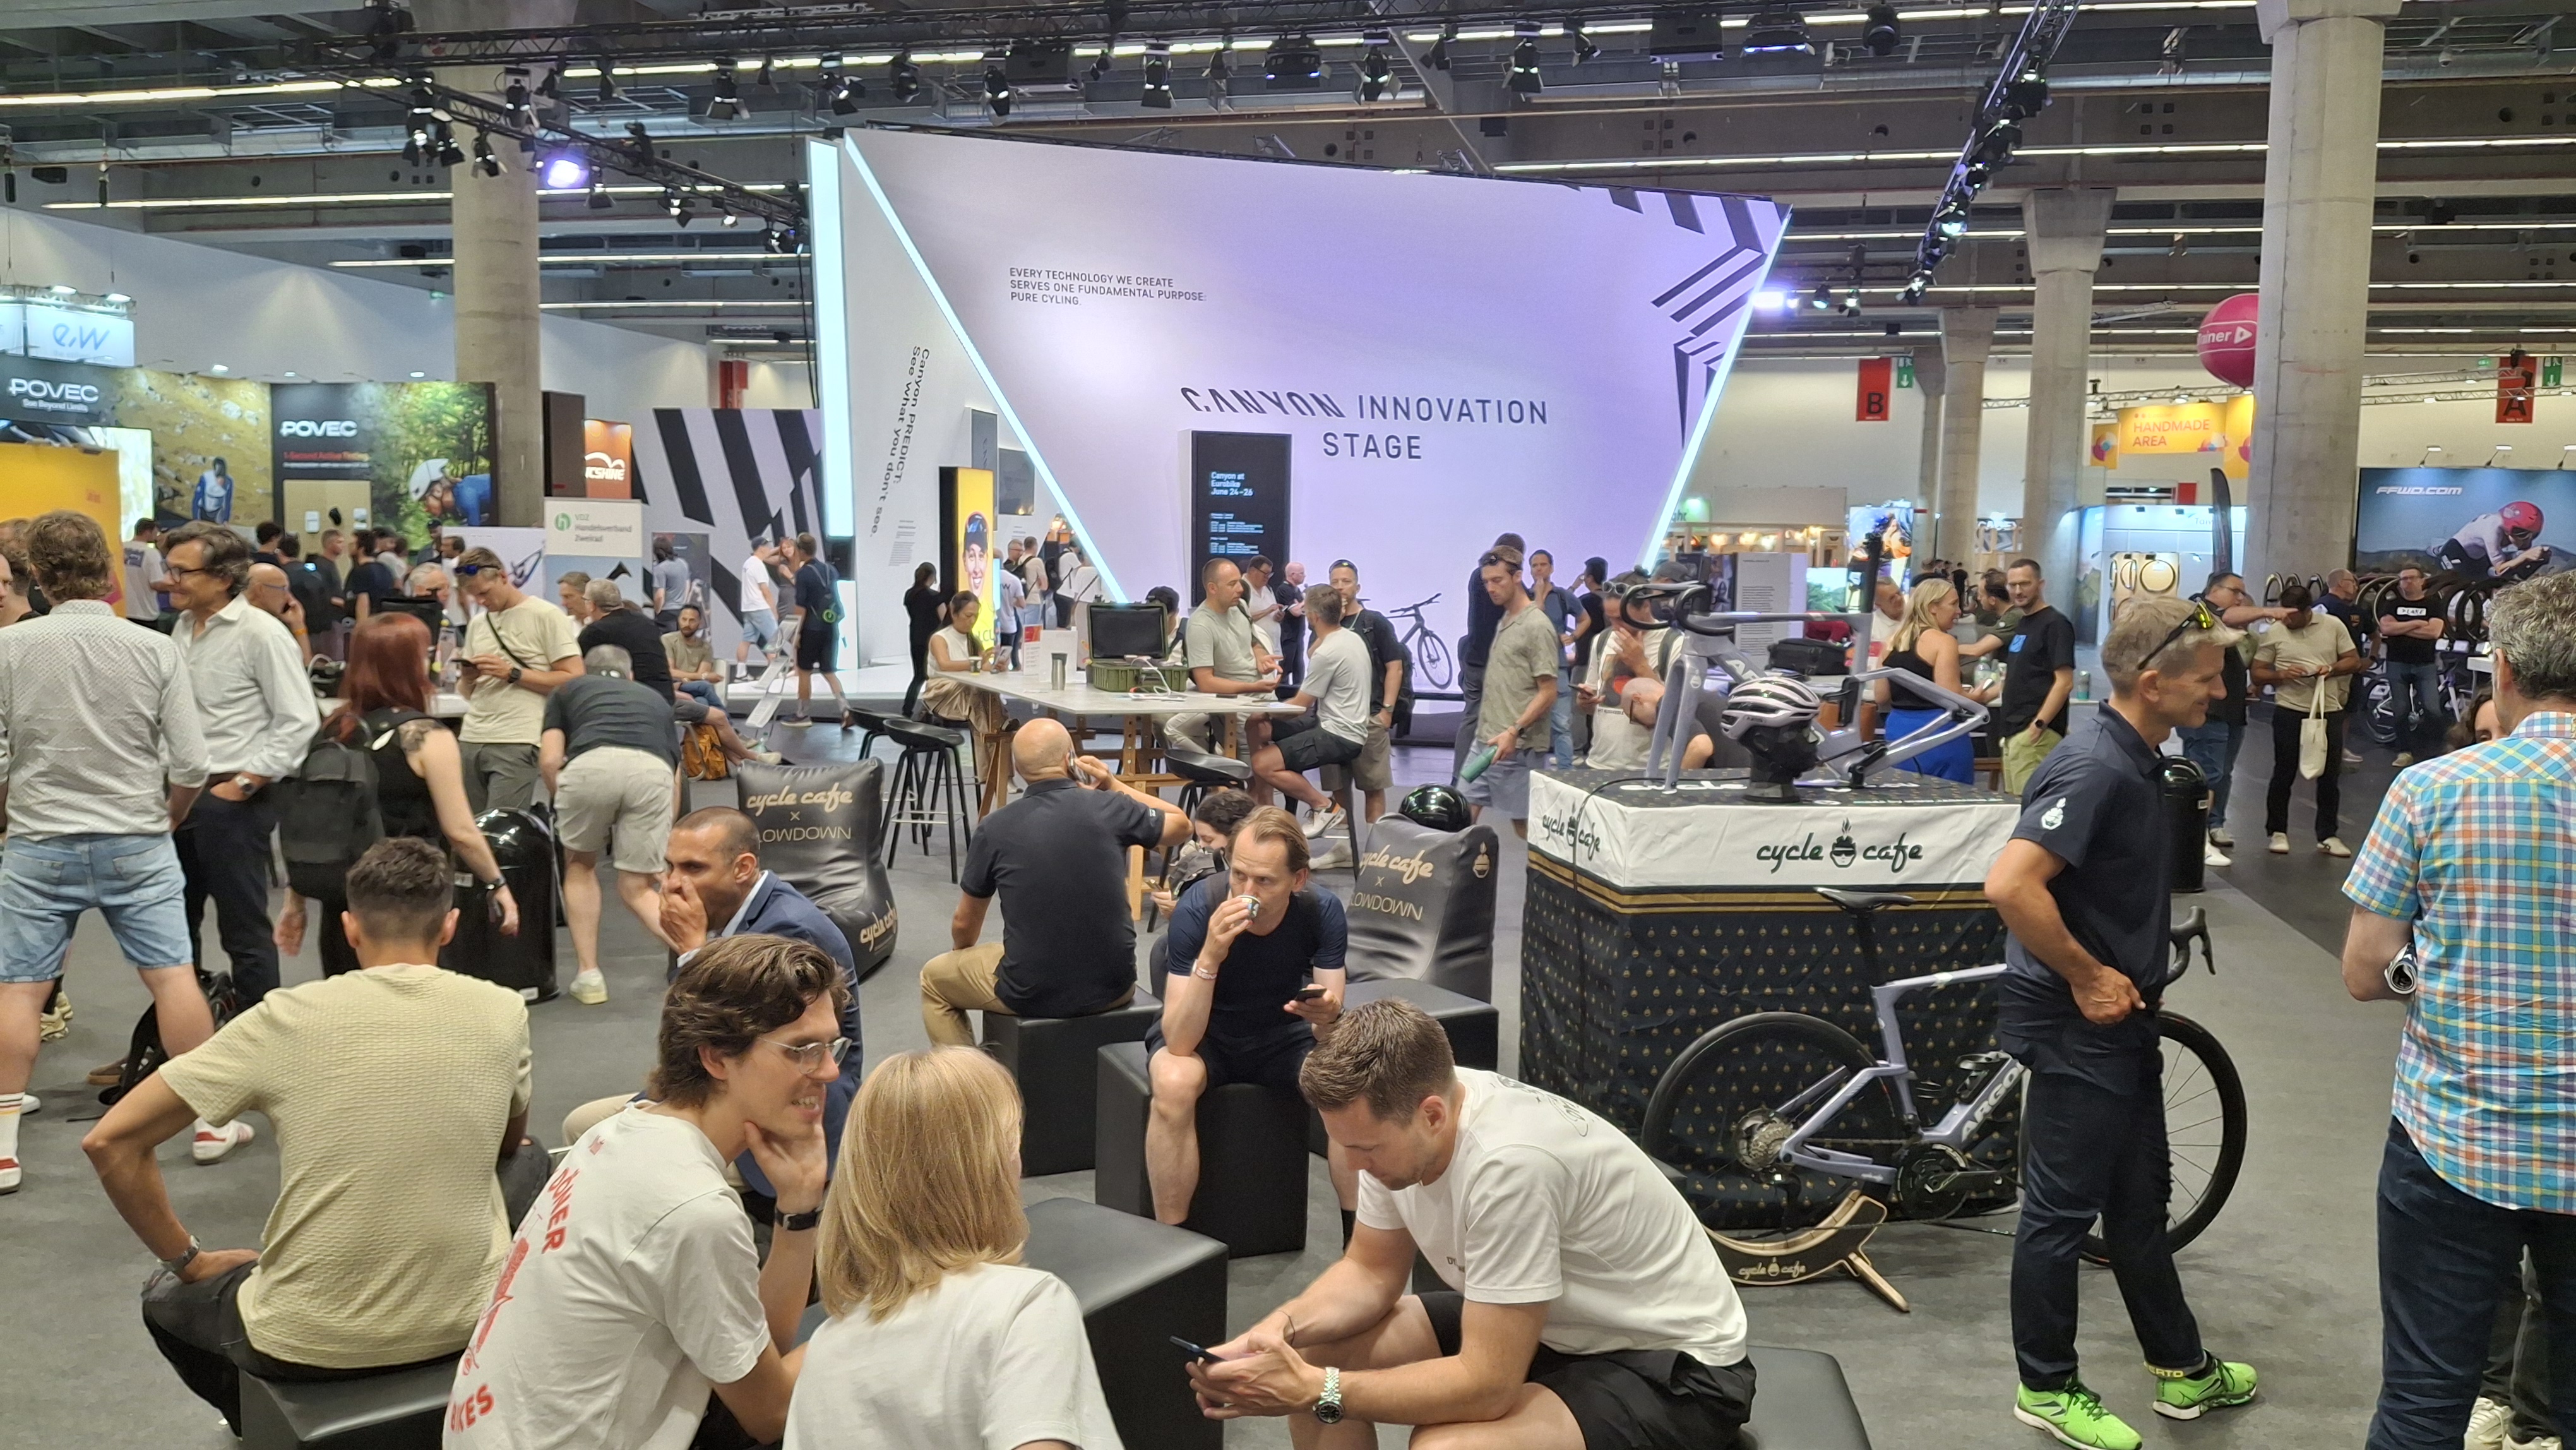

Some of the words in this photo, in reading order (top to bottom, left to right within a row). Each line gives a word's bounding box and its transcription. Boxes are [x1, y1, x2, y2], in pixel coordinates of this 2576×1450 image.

[1010, 267, 1043, 279] EVERY
[1045, 270, 1114, 284] TECHNOLOGY
[1116, 275, 1133, 285] WE
[1136, 277, 1174, 287] CREATE
[1010, 280, 1050, 291] SERVES
[1054, 283, 1075, 293] ONE
[1078, 285, 1155, 298] FUNDAMENTAL
[1010, 292, 1038, 302] PURE
[909, 345, 921, 376] See
[911, 348, 930, 407] Canyon
[9, 378, 99, 402] POVEC
[898, 381, 912, 423] what
[1180, 386, 1347, 418] CANYON
[1358, 395, 1548, 424] INNOVATION
[1867, 392, 1883, 414] B
[2503, 393, 2526, 416] A
[280, 420, 358, 438] POVEC
[2133, 419, 2210, 433] HANDMADE
[890, 428, 902, 457] you
[893, 414, 916, 484] PREDICT:
[1322, 432, 1422, 460] STAGE
[2133, 436, 2167, 447] AREA
[1210, 471, 1236, 481] Canyon
[1210, 488, 1229, 496] June
[746, 785, 797, 817] cycle
[801, 782, 853, 813] cafe
[758, 826, 852, 844] OWDOWN
[1542, 809, 1565, 842] cycle
[1578, 822, 1601, 861] cafe
[1756, 832, 1825, 875] cycle
[1863, 832, 1924, 874] cafe
[1388, 849, 1434, 884] cafe
[860, 911, 887, 952] cycle
[1738, 1262, 1767, 1279] cycle
[1780, 1261, 1806, 1278] cafe
